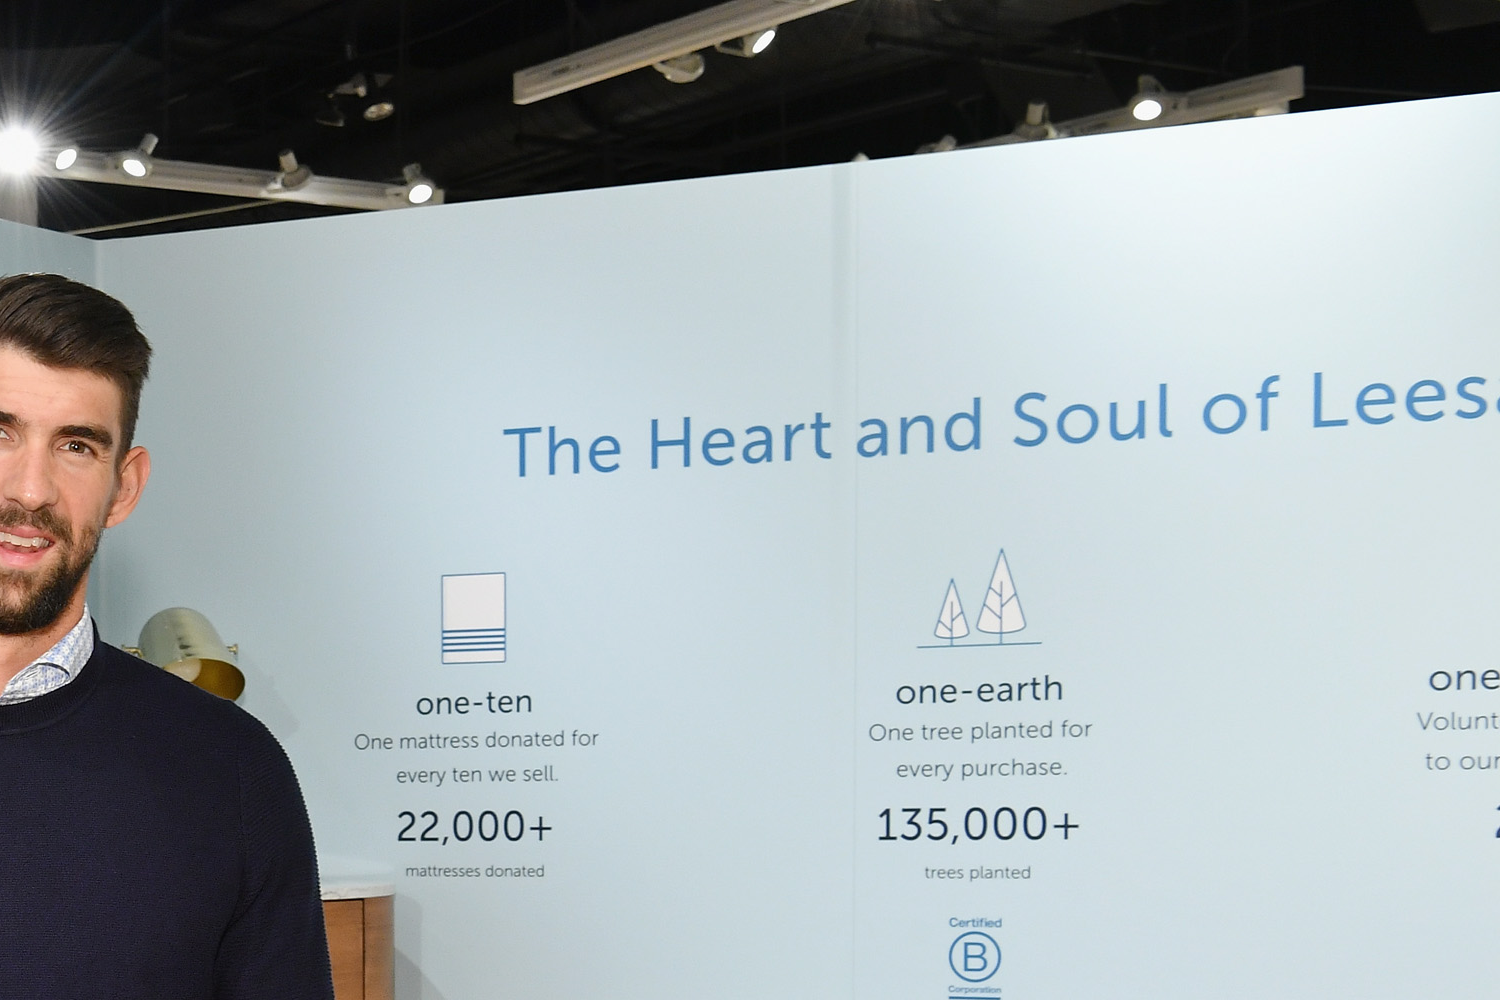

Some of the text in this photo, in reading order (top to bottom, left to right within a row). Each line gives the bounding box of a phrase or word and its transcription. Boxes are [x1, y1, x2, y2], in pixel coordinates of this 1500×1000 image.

[503, 372, 1500, 477] The Heart and Soul of Lees
[897, 675, 1062, 704] one-earth
[1429, 670, 1500, 691] one
[417, 692, 531, 715] one-ten
[869, 720, 1092, 743] One tree planted for
[1417, 712, 1498, 730] Volunt
[355, 730, 599, 750] One mattress donated for
[897, 759, 1067, 781] every purchase.
[1426, 754, 1450, 770] to
[397, 765, 558, 787] every ten we sell.
[398, 811, 552, 845] 22,000+
[879, 807, 1079, 844] 135,000+
[406, 865, 544, 877] mattresses donated
[925, 866, 1030, 882] trees planted
[949, 917, 1002, 928] Certified
